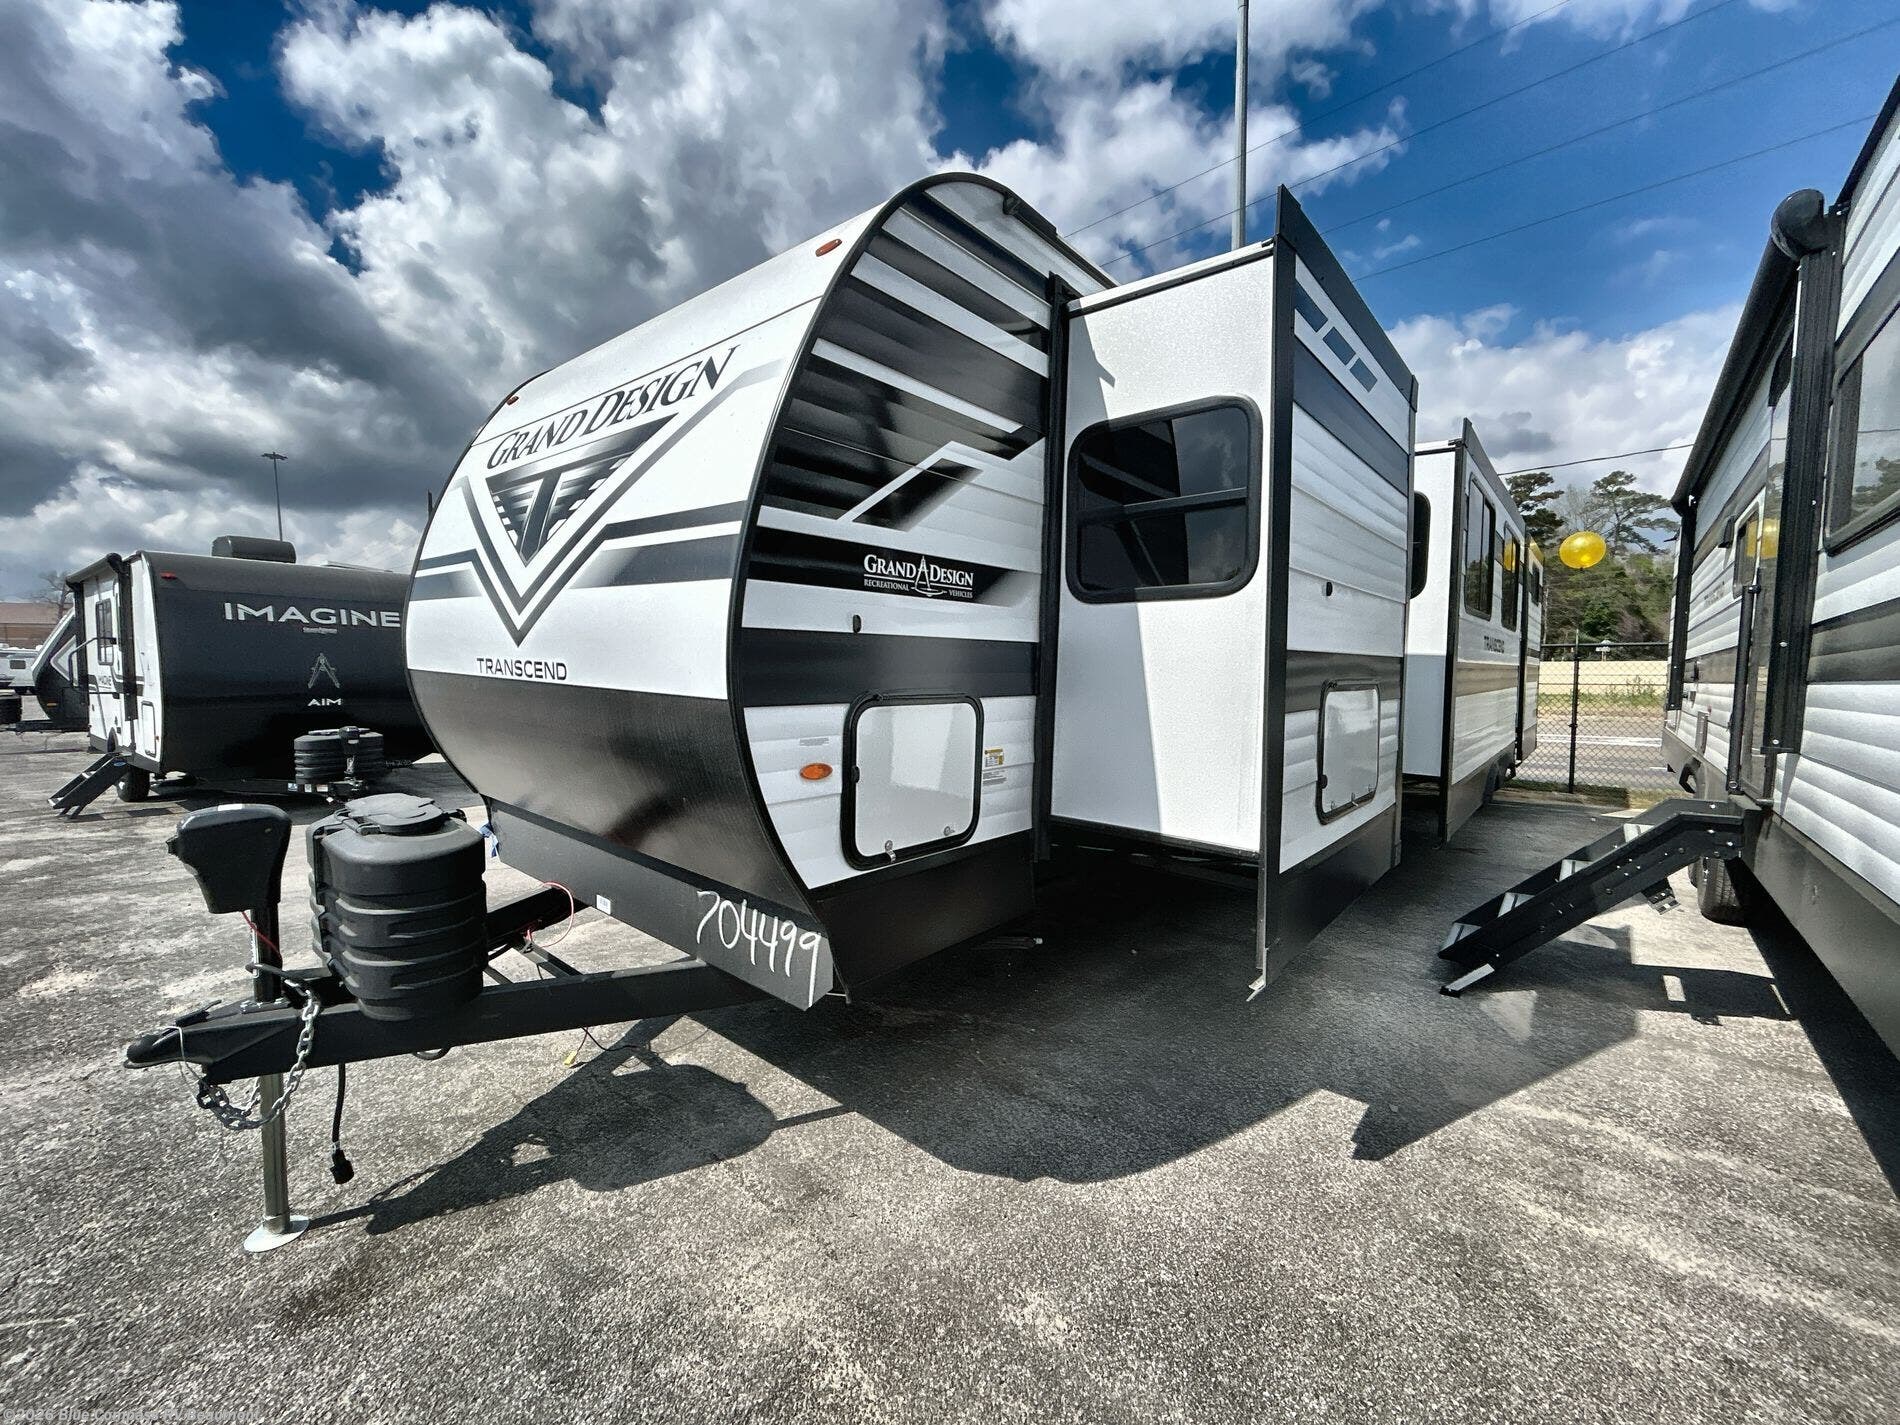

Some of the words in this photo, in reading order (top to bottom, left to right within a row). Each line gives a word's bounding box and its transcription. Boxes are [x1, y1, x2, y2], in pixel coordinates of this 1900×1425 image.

[487, 408, 588, 470] GRAND
[582, 344, 742, 436] DESIGN
[863, 553, 917, 579] GRAND
[929, 563, 975, 587] DESIGN
[863, 578, 910, 592] RECREATIONAL
[948, 590, 973, 599] VEHICLES
[223, 602, 401, 628] IMAGINE
[476, 657, 567, 681] TRANSCEND
[307, 698, 342, 707] AIM
[696, 890, 822, 1008] 704499
